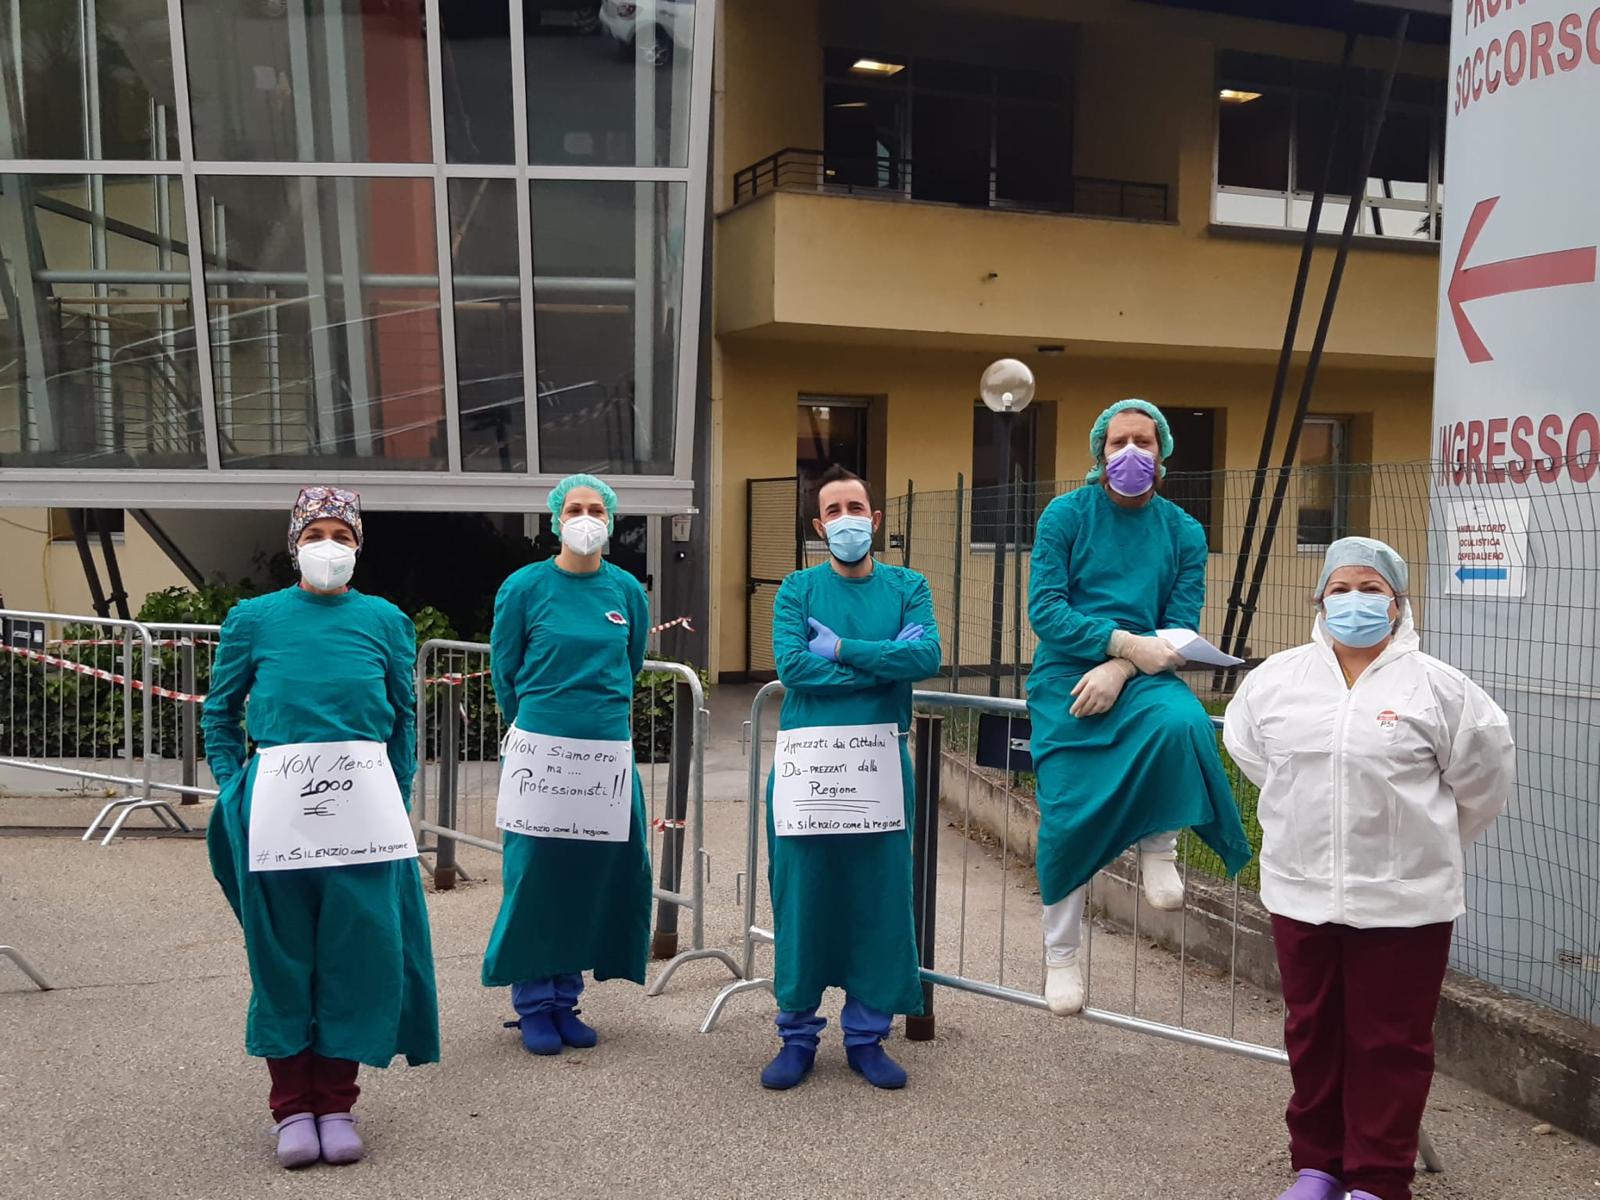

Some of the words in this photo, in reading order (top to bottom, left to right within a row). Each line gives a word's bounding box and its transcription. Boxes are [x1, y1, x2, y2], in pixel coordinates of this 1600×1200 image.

[1438, 412, 1600, 487] INGRESSO
[301, 779, 353, 797] 1000
[808, 781, 857, 798] Regione
